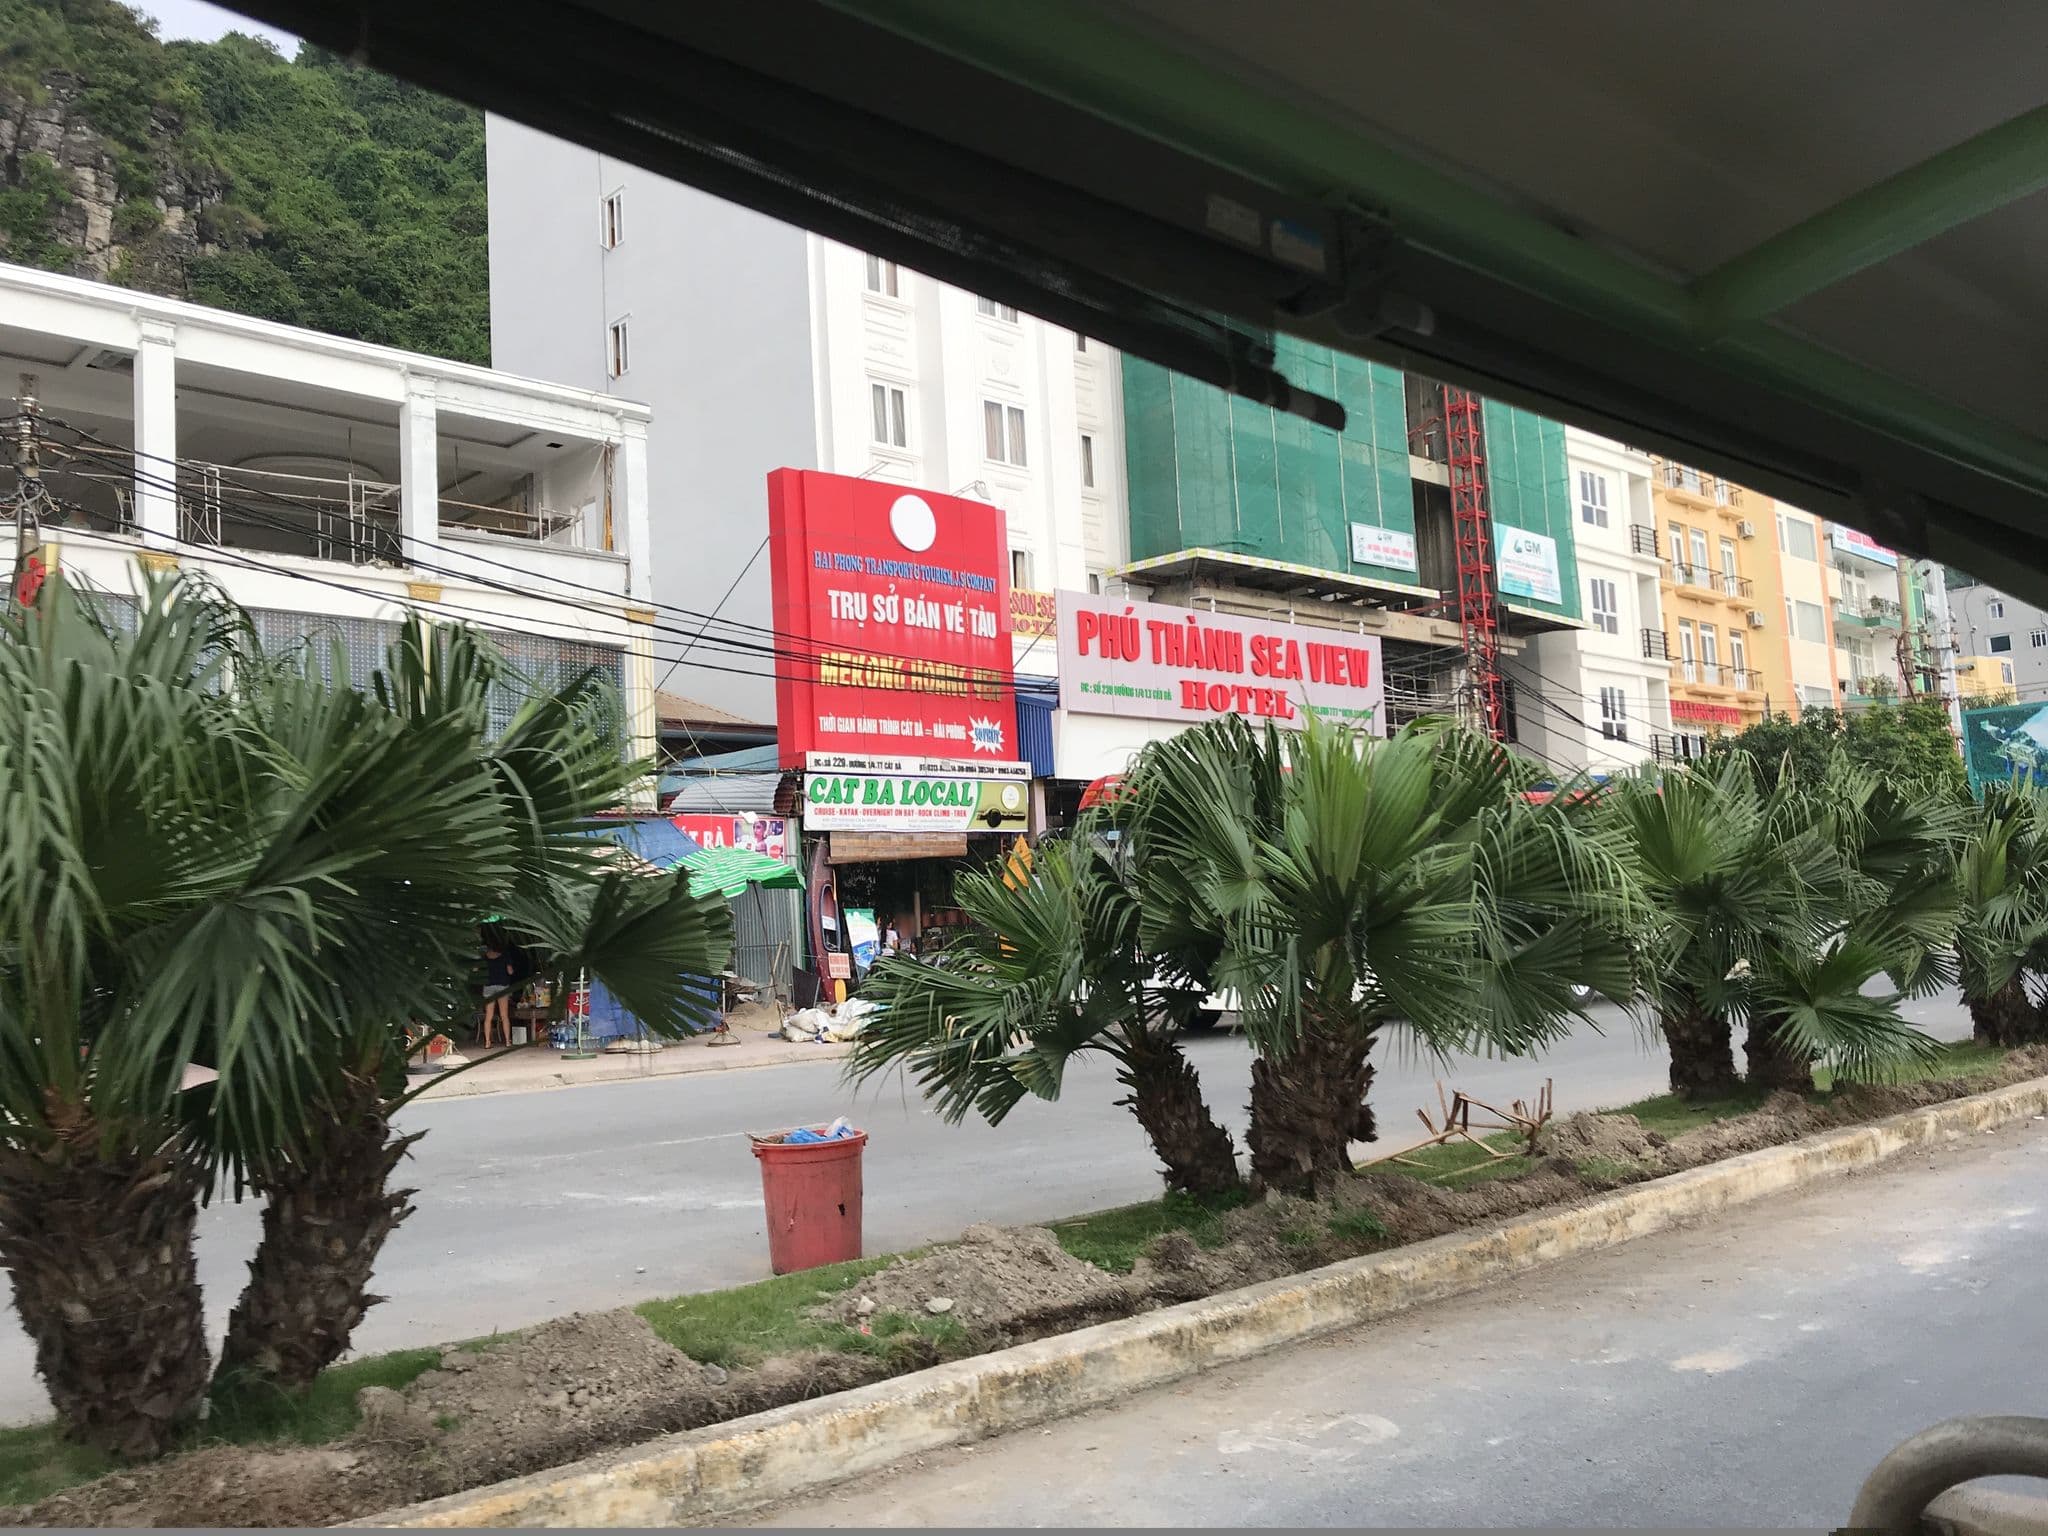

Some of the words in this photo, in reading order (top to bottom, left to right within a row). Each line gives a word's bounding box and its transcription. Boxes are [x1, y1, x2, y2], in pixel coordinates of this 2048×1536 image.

[1524, 540, 1541, 555] GM
[814, 550, 832, 569] HAI
[834, 553, 863, 573] PHONG
[865, 557, 913, 579] TRANSPORT
[828, 589, 867, 628] TRỤ
[873, 584, 899, 624] SỞ
[903, 594, 940, 631] BÁN
[943, 600, 965, 635] VÉ
[969, 604, 997, 639] TÀU
[1077, 606, 1141, 662] PHÚ
[1147, 615, 1244, 673] THÀNH
[1251, 634, 1303, 681] SEA
[1306, 642, 1369, 688] VIEW
[820, 652, 906, 690] MEKONG
[1179, 680, 1294, 720] HOTEL
[837, 716, 856, 733] GIAN
[857, 715, 878, 734] HÀNH
[900, 718, 913, 736] CÁT
[914, 718, 924, 737] BÀ
[809, 777, 860, 804] CAT
[862, 779, 895, 805] BA
[899, 780, 974, 807] LOCAL
[814, 807, 836, 816] CRUISE
[839, 807, 858, 816] KAYAK
[862, 808, 893, 817] OVERNIGHT
[894, 808, 903, 817] ON
[903, 808, 914, 817] BAY
[918, 808, 932, 817] ROCK
[934, 808, 950, 817] CLIMB
[953, 809, 967, 817] TREK
